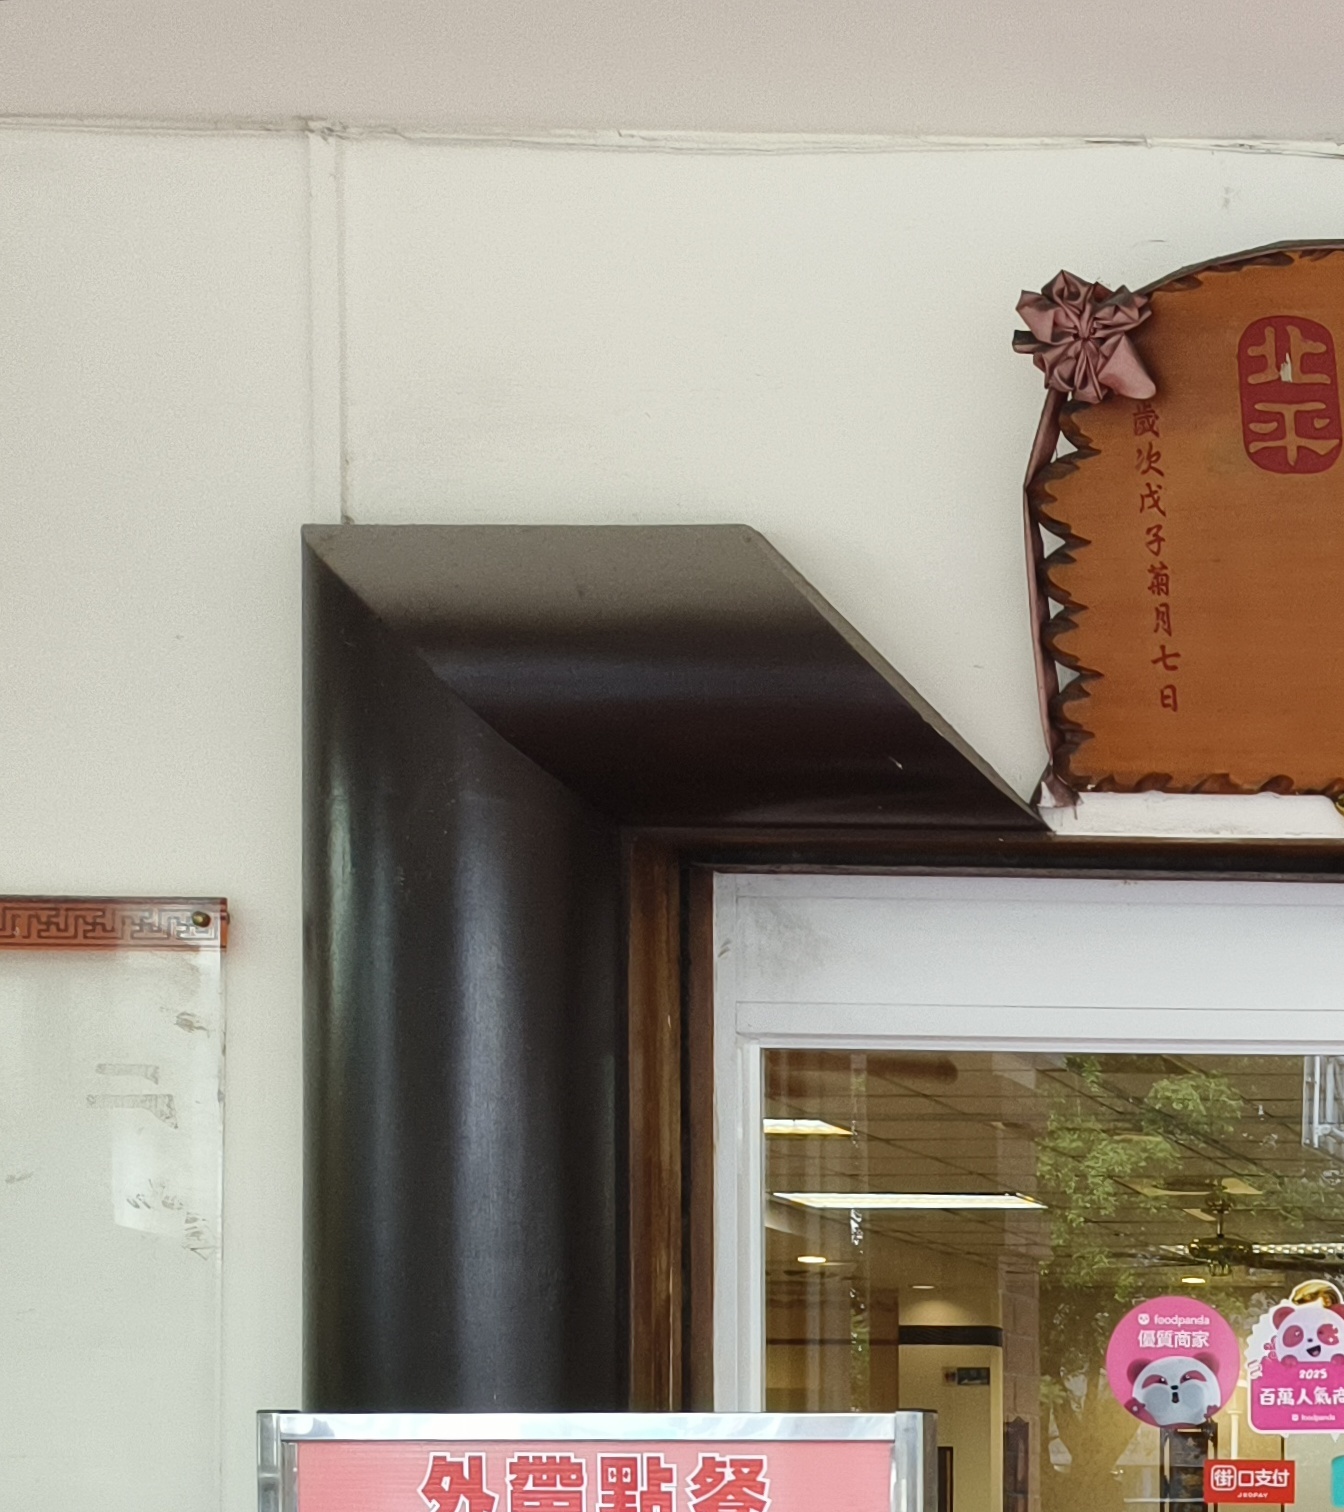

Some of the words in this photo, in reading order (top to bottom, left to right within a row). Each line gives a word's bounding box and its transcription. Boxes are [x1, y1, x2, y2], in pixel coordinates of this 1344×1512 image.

[1246, 325, 1339, 467] 北平
[1154, 1314, 1210, 1328] foodpanda
[1138, 1330, 1210, 1349] 優質商家
[1298, 1368, 1328, 1380] 2025
[1212, 1465, 1290, 1491] 街口支付
